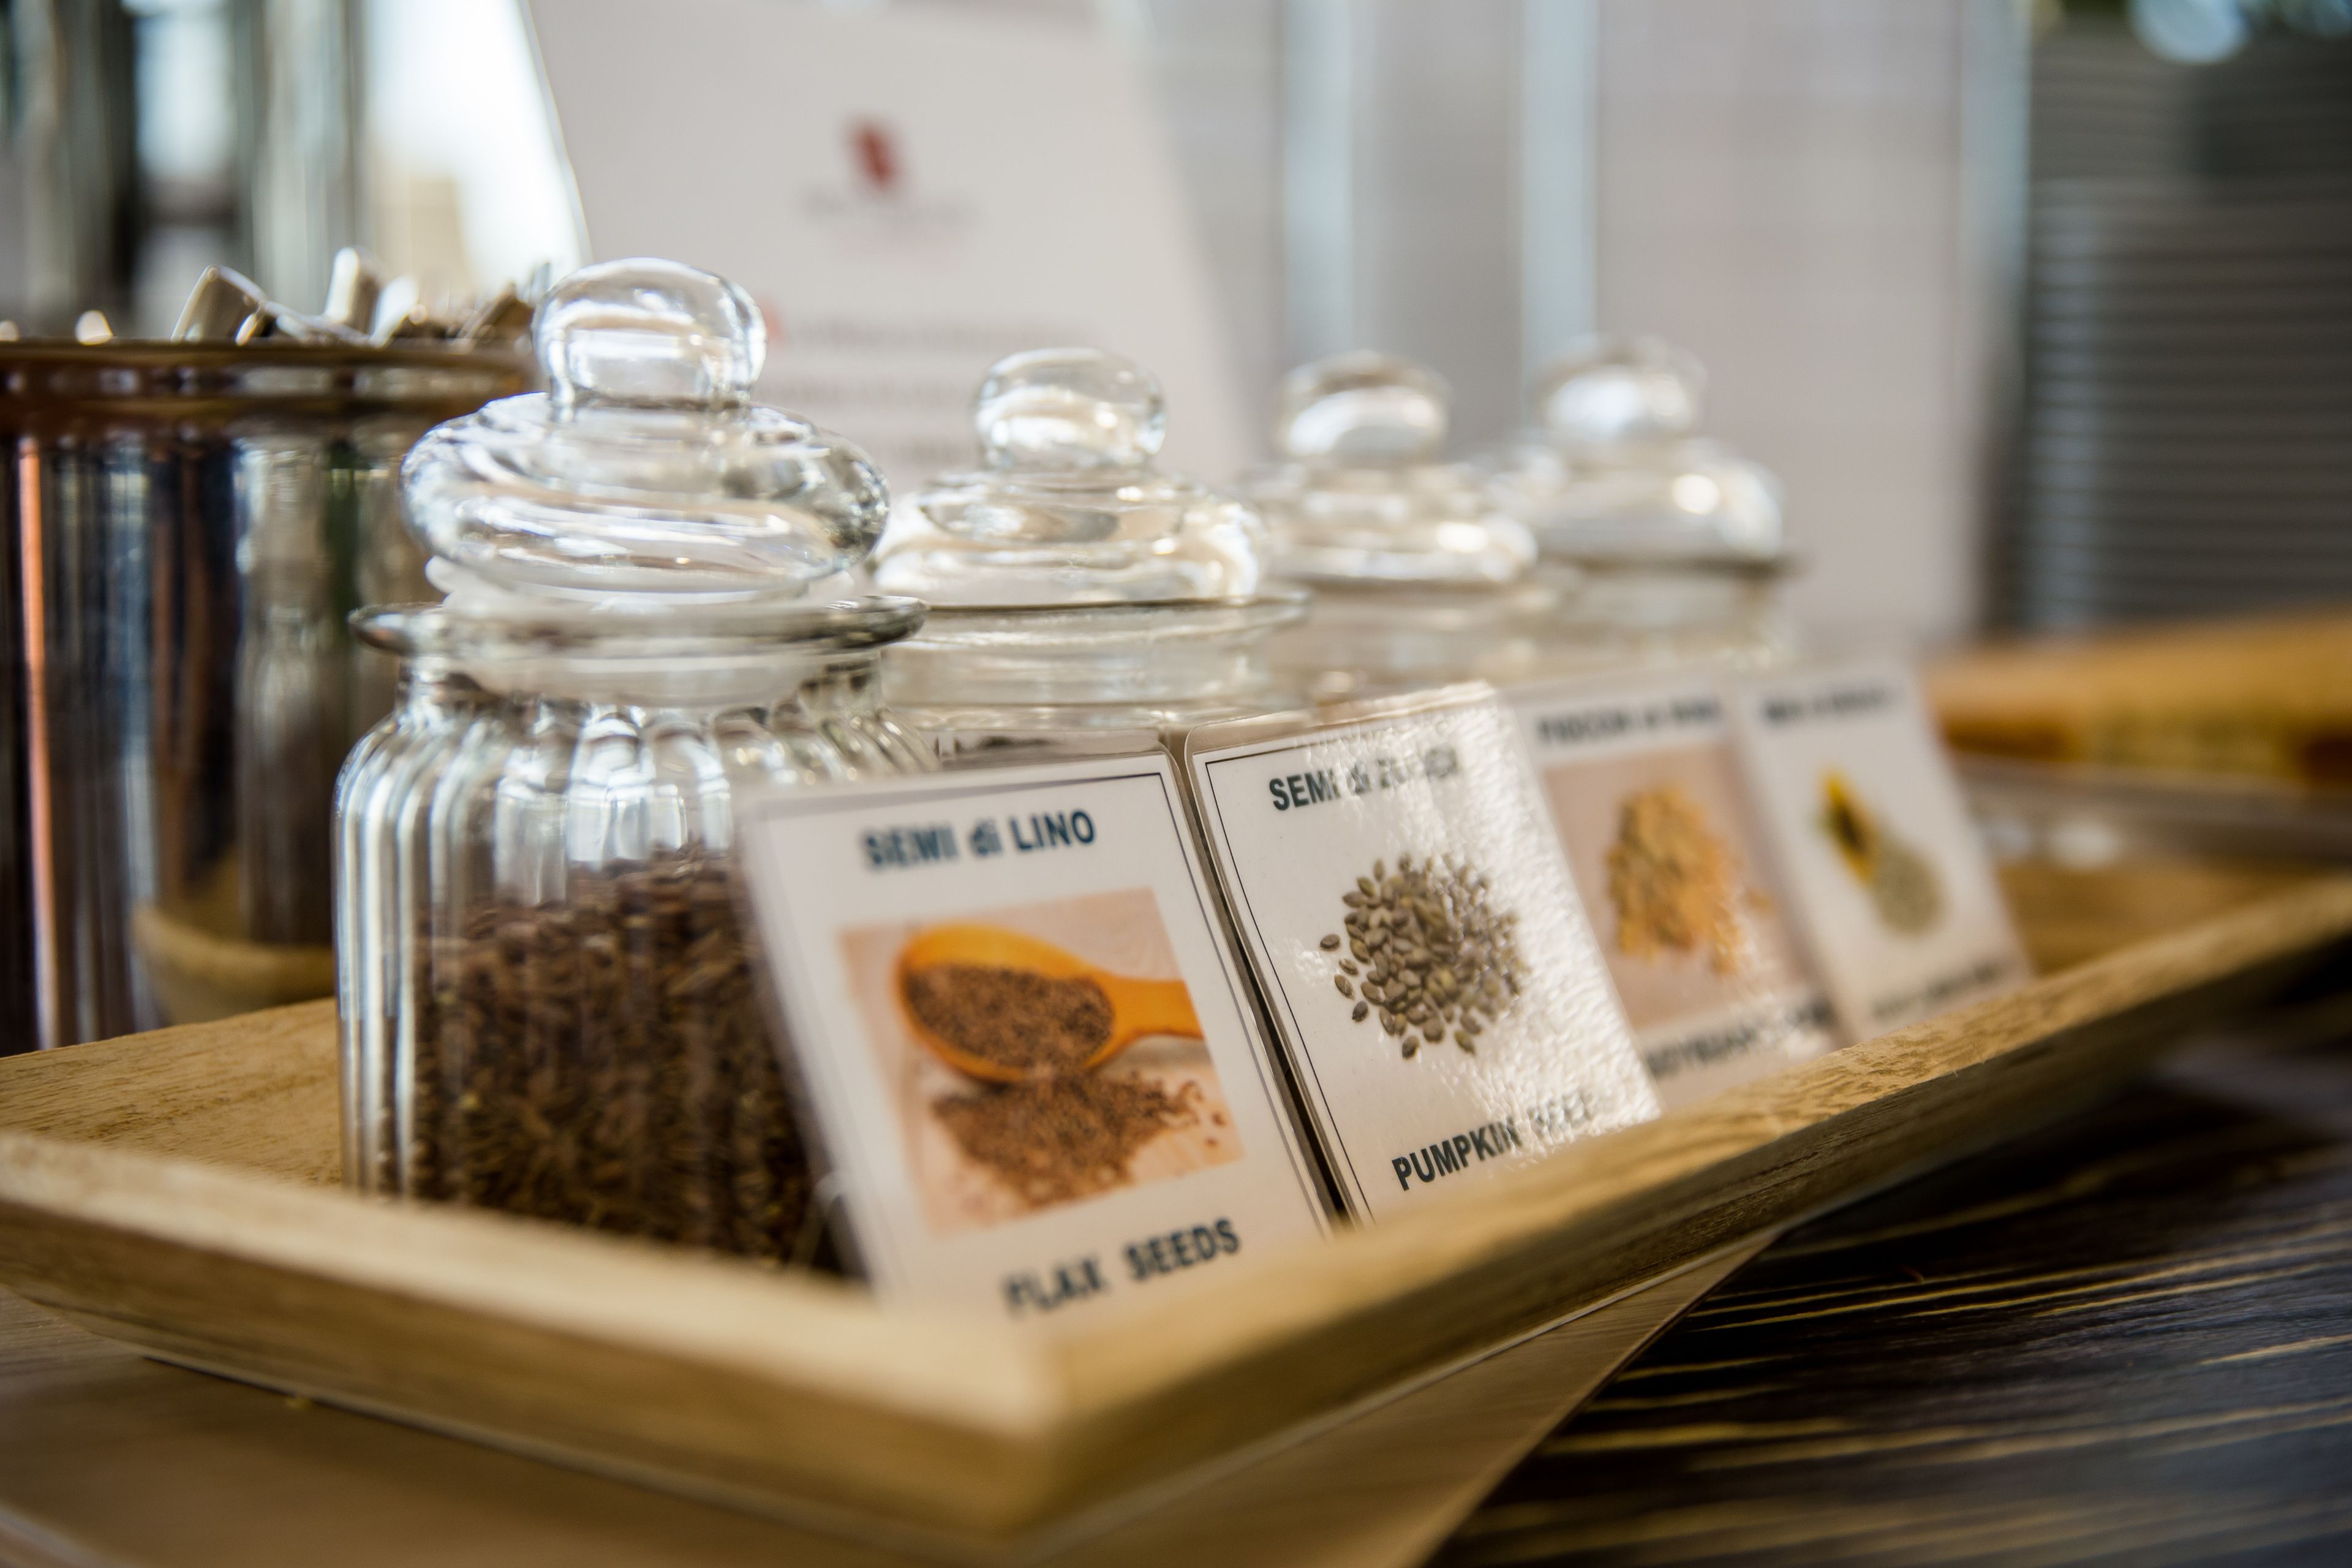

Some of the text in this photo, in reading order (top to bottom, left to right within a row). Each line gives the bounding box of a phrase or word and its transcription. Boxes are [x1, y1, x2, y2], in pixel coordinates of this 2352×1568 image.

[860, 820, 959, 871] SEMI
[1008, 807, 1096, 852] LINO
[1391, 1115, 1524, 1191] PUMPKIN
[1001, 1216, 1242, 1318] FLAX SEEDS
